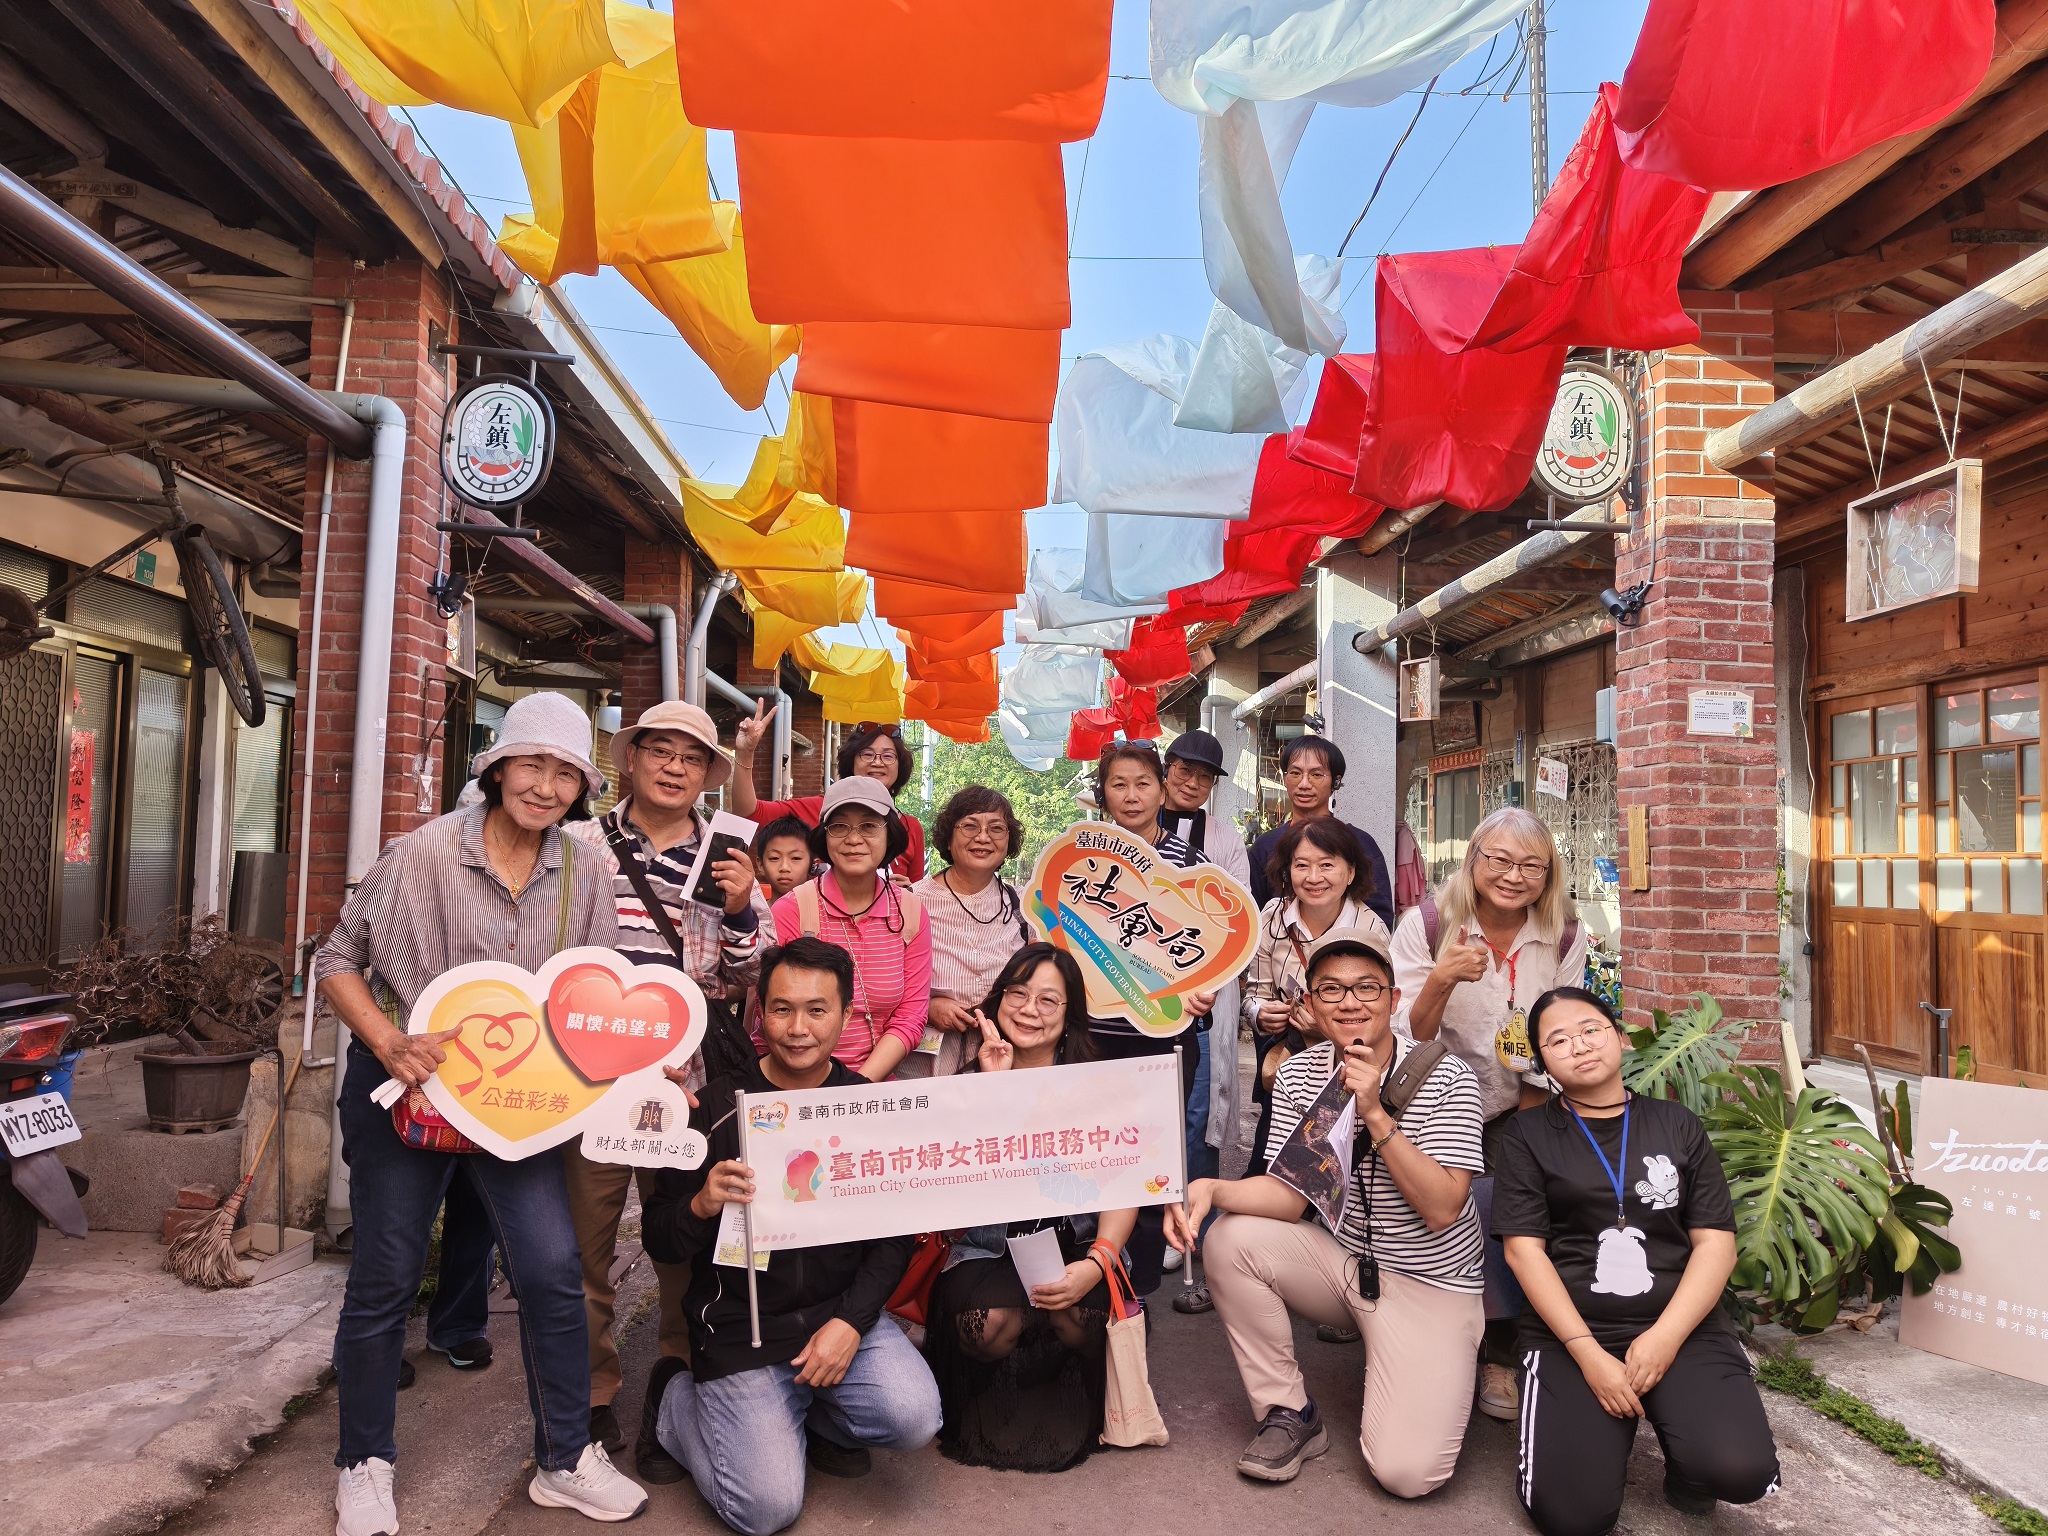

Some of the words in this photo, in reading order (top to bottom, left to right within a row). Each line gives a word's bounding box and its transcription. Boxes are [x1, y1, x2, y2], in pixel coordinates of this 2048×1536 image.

[485, 402, 512, 449] 左鎮
[1570, 392, 1594, 441] 左鎮
[1076, 831, 1154, 873] 臺南市政府
[1062, 858, 1207, 971] 社會局
[1058, 909, 1090, 942] TAINAN
[1087, 938, 1107, 963] CITY
[1104, 960, 1156, 1018] GOVERNMENT
[1128, 959, 1152, 975] BUREAU
[1131, 953, 1152, 968] SOCIAL
[1152, 964, 1176, 981] AFFAIRS
[481, 1087, 570, 1113] 公益彩券
[798, 1095, 929, 1121] 臺南市政府社會局
[595, 1136, 696, 1158] 財政部關心您
[829, 1126, 1140, 1182] 臺南市婦女福利服務中心
[830, 1184, 876, 1198] Tainan
[880, 1179, 906, 1194] City
[909, 1169, 989, 1189] Government
[1053, 1159, 1097, 1174] Service
[1100, 1155, 1141, 1168] Center
[1971, 1184, 2033, 1202] ZUODA
[1961, 1197, 2041, 1220] 左達商號
[1935, 1284, 1987, 1307] 在地嚴選
[1933, 1301, 1986, 1323] 地方創生
